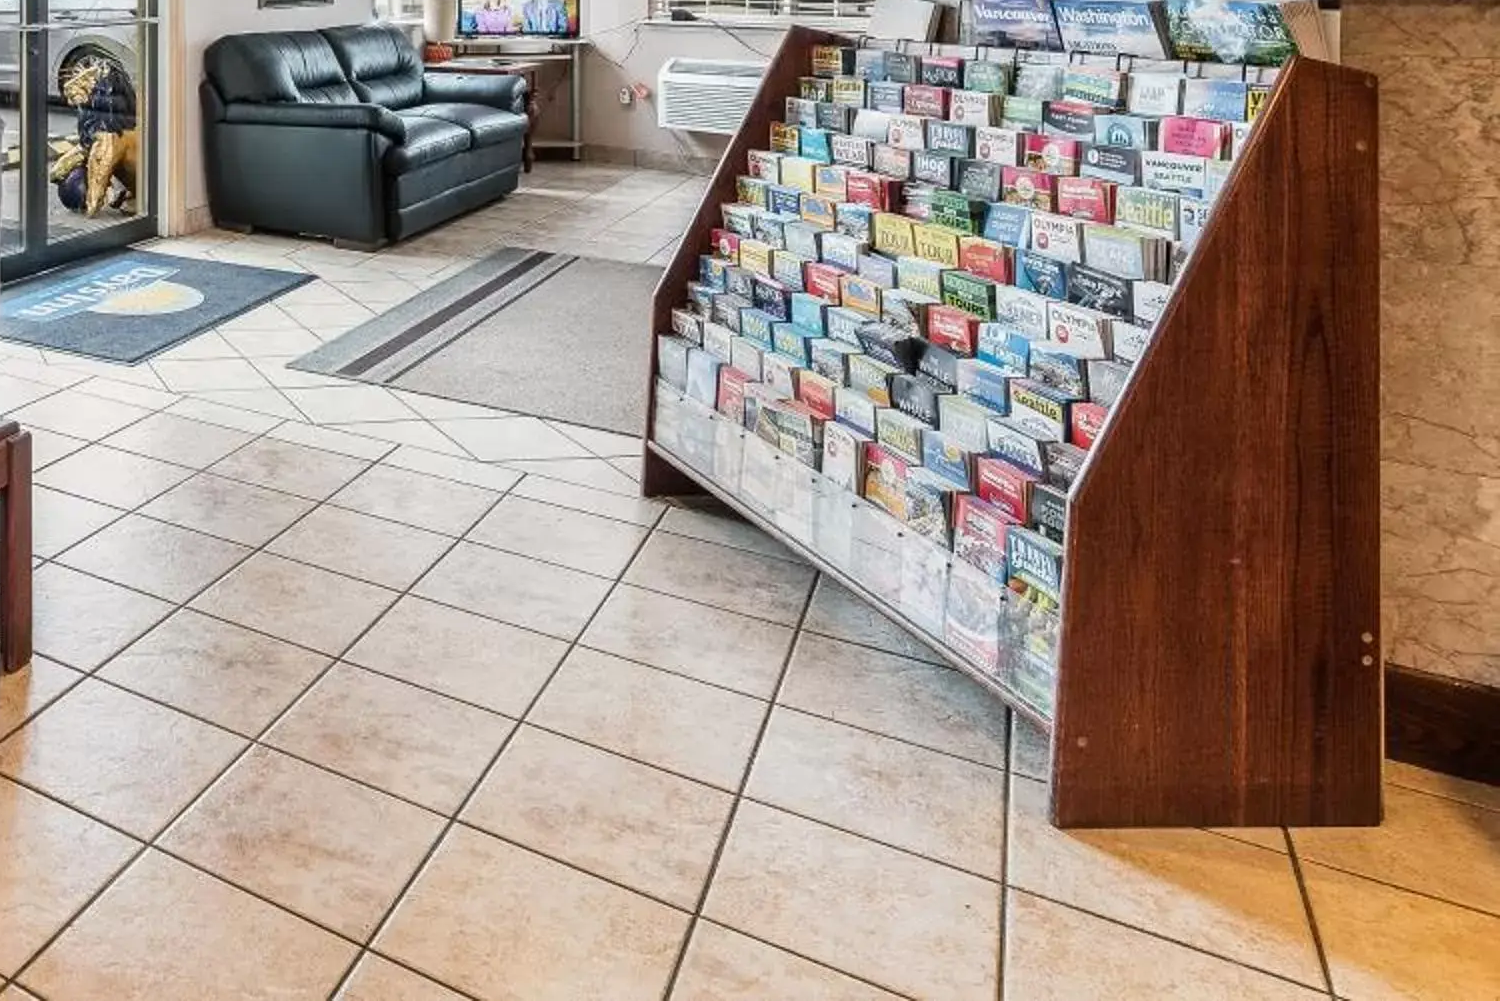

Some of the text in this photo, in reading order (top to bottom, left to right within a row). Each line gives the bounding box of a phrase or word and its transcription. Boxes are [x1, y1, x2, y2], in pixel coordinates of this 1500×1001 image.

[973, 3, 1051, 23] Vancouver
[1058, 6, 1149, 27] Washington
[1145, 159, 1203, 172] VANCOUVER
[1153, 172, 1192, 184] SEATTLE
[1116, 198, 1175, 231] Seattle
[1033, 217, 1074, 234] OLYMPIA
[1013, 389, 1058, 420] Seattle
